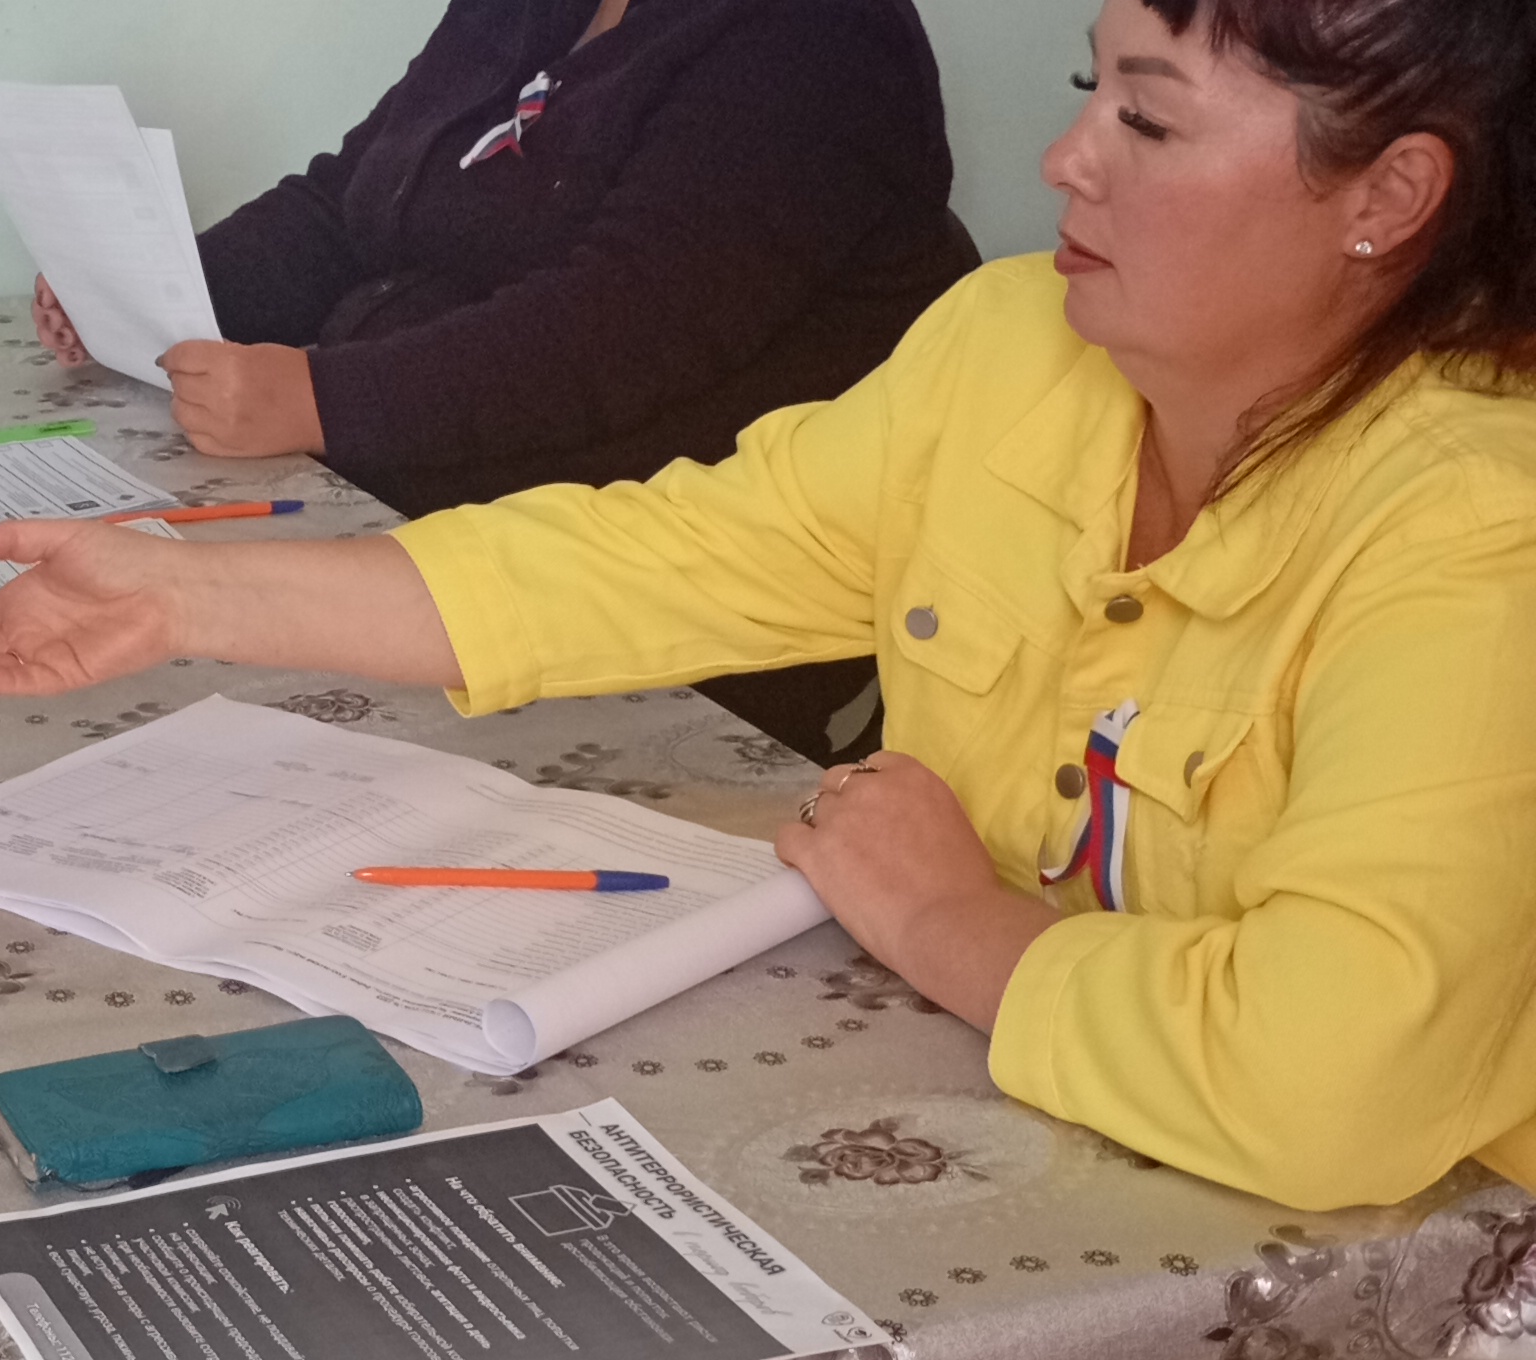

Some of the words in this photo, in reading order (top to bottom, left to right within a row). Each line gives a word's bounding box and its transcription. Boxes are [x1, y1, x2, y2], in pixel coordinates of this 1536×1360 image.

[569, 1129, 677, 1220] БЕЗОПАСНОСТЬ
[599, 1122, 784, 1277] АНТИТЕРРОРИСТИЧЕСКАЯ
[224, 1220, 247, 1238] Как
[443, 1176, 466, 1189] На
[472, 1203, 518, 1243] обратить
[24, 1302, 64, 1346] Телефоны:
